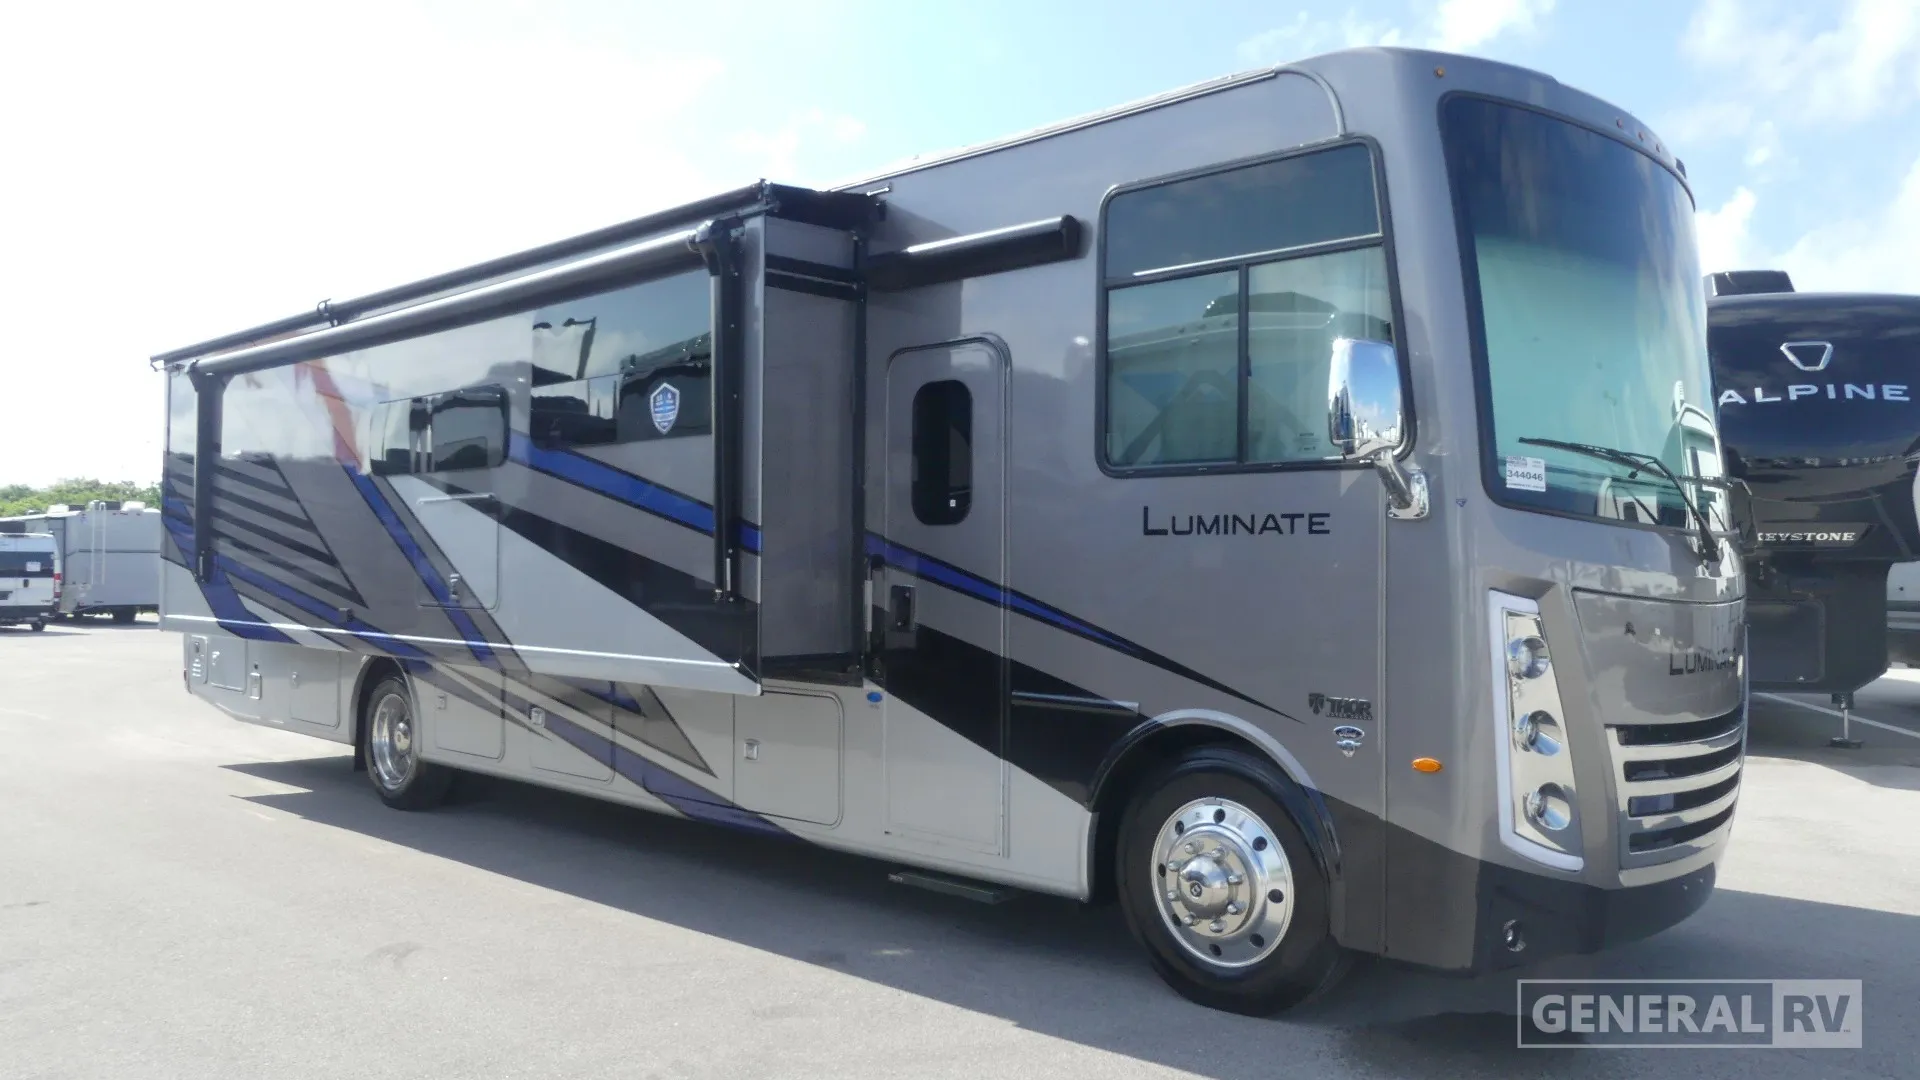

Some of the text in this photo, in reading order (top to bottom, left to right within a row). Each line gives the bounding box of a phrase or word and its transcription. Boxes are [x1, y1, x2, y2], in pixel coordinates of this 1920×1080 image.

[1719, 384, 1910, 406] ALPINE
[1507, 470, 1543, 481] 344046
[1143, 505, 1331, 536] LUMINATE
[1326, 696, 1372, 715] THOR
